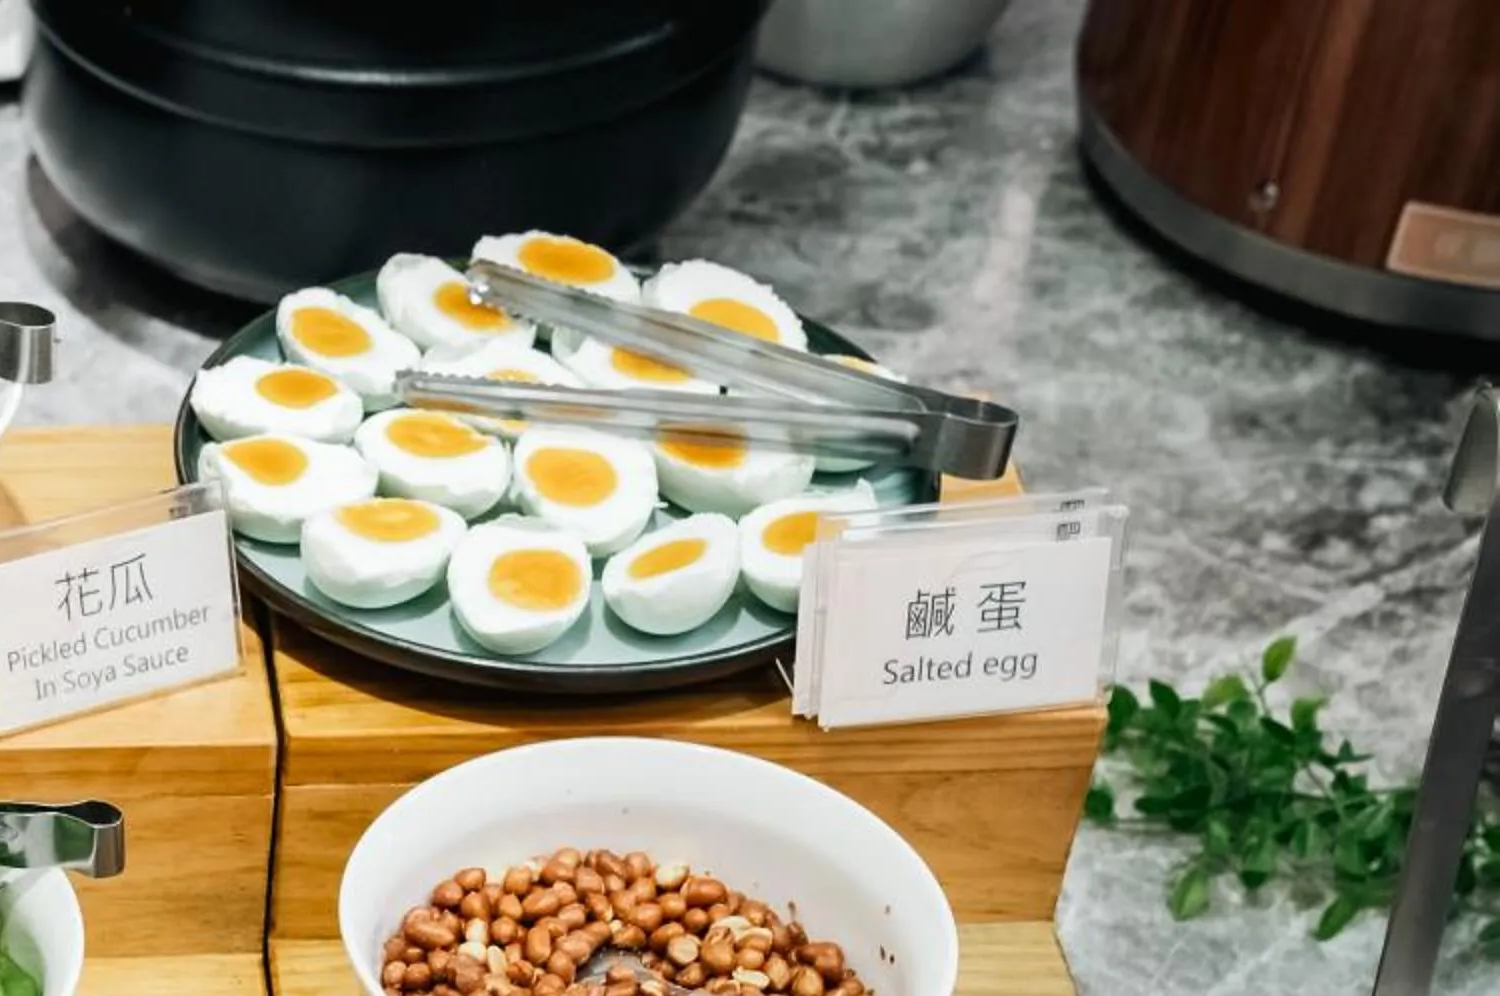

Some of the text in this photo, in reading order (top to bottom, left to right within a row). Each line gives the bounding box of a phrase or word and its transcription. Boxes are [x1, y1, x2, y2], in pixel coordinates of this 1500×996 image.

[55, 553, 154, 622] 花瓜
[905, 580, 1027, 641] 鹹蛋
[6, 605, 211, 673] Pickled Cucumber
[883, 651, 1039, 685] Salted egg
[35, 645, 190, 700] In Soya Sauce
